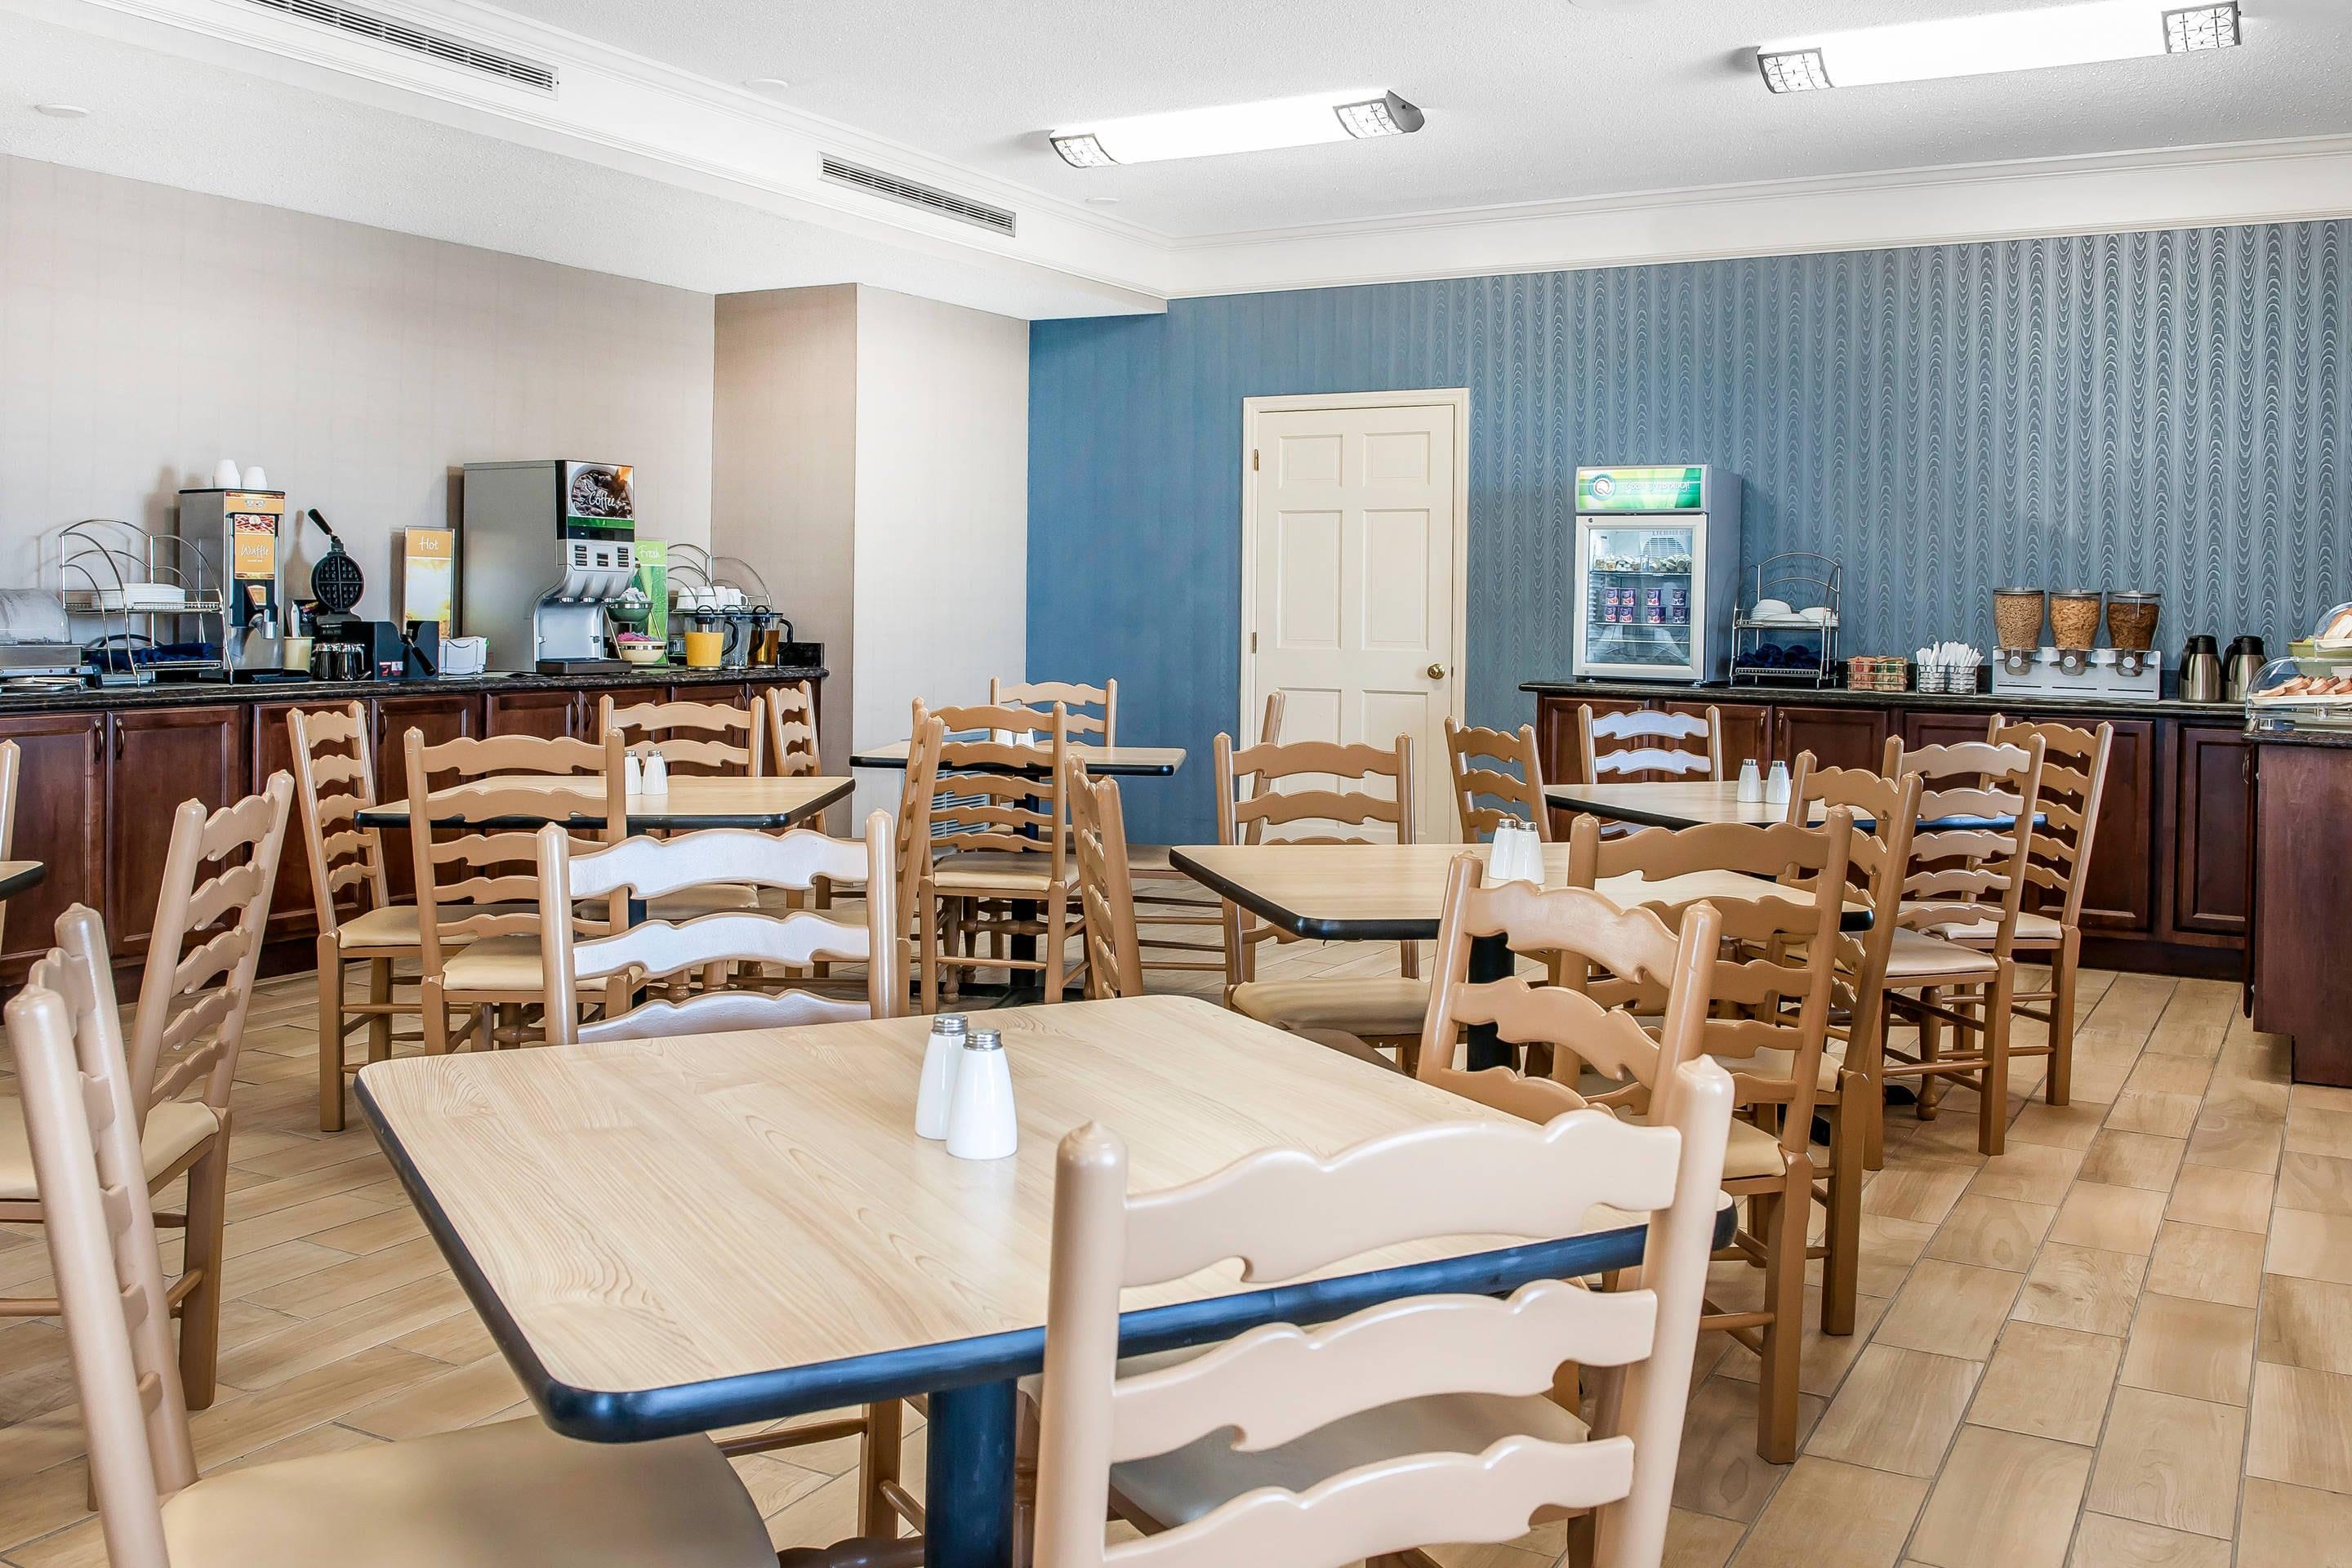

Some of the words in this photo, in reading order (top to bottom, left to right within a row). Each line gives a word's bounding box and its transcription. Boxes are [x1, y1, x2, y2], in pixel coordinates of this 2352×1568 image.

[589, 491, 616, 510] Coffee
[241, 542, 270, 559] Waffle
[419, 535, 439, 551] Hot
